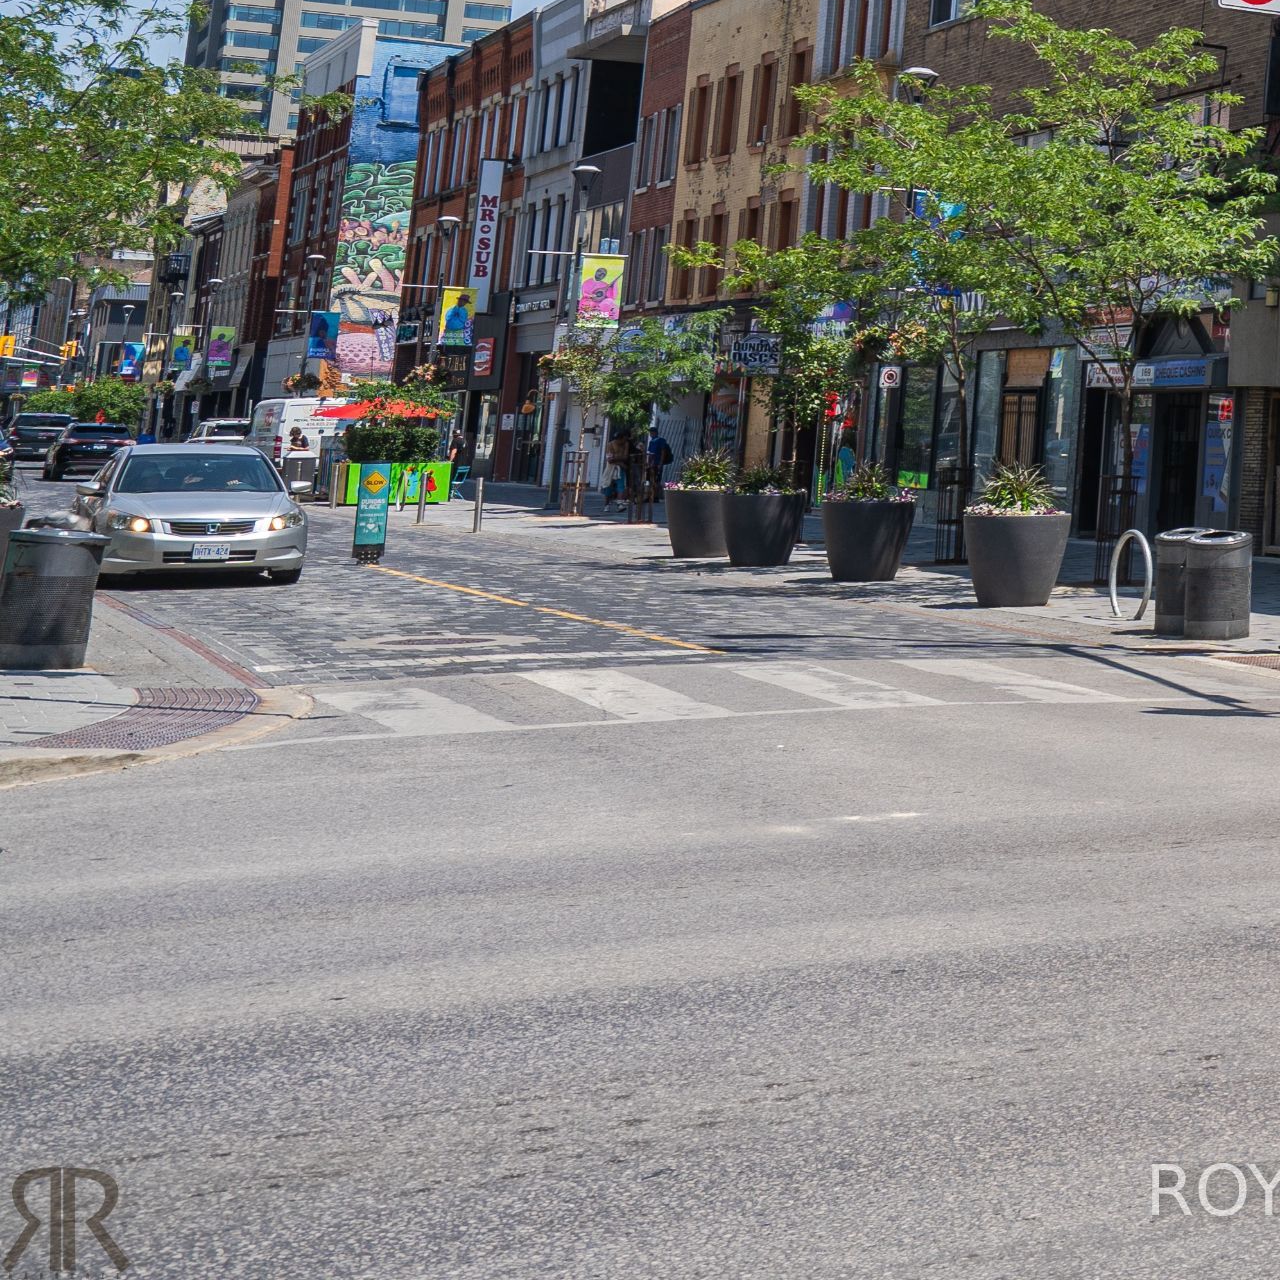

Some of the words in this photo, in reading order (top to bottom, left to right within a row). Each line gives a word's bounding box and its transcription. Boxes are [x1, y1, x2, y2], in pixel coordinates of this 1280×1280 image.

[480, 194, 499, 222] MR
[473, 237, 491, 277] SUB
[733, 341, 779, 353] DUNDAS
[733, 352, 778, 363] DISCS
[1155, 366, 1178, 379] CHEQUE
[1179, 365, 1206, 378] CASHING
